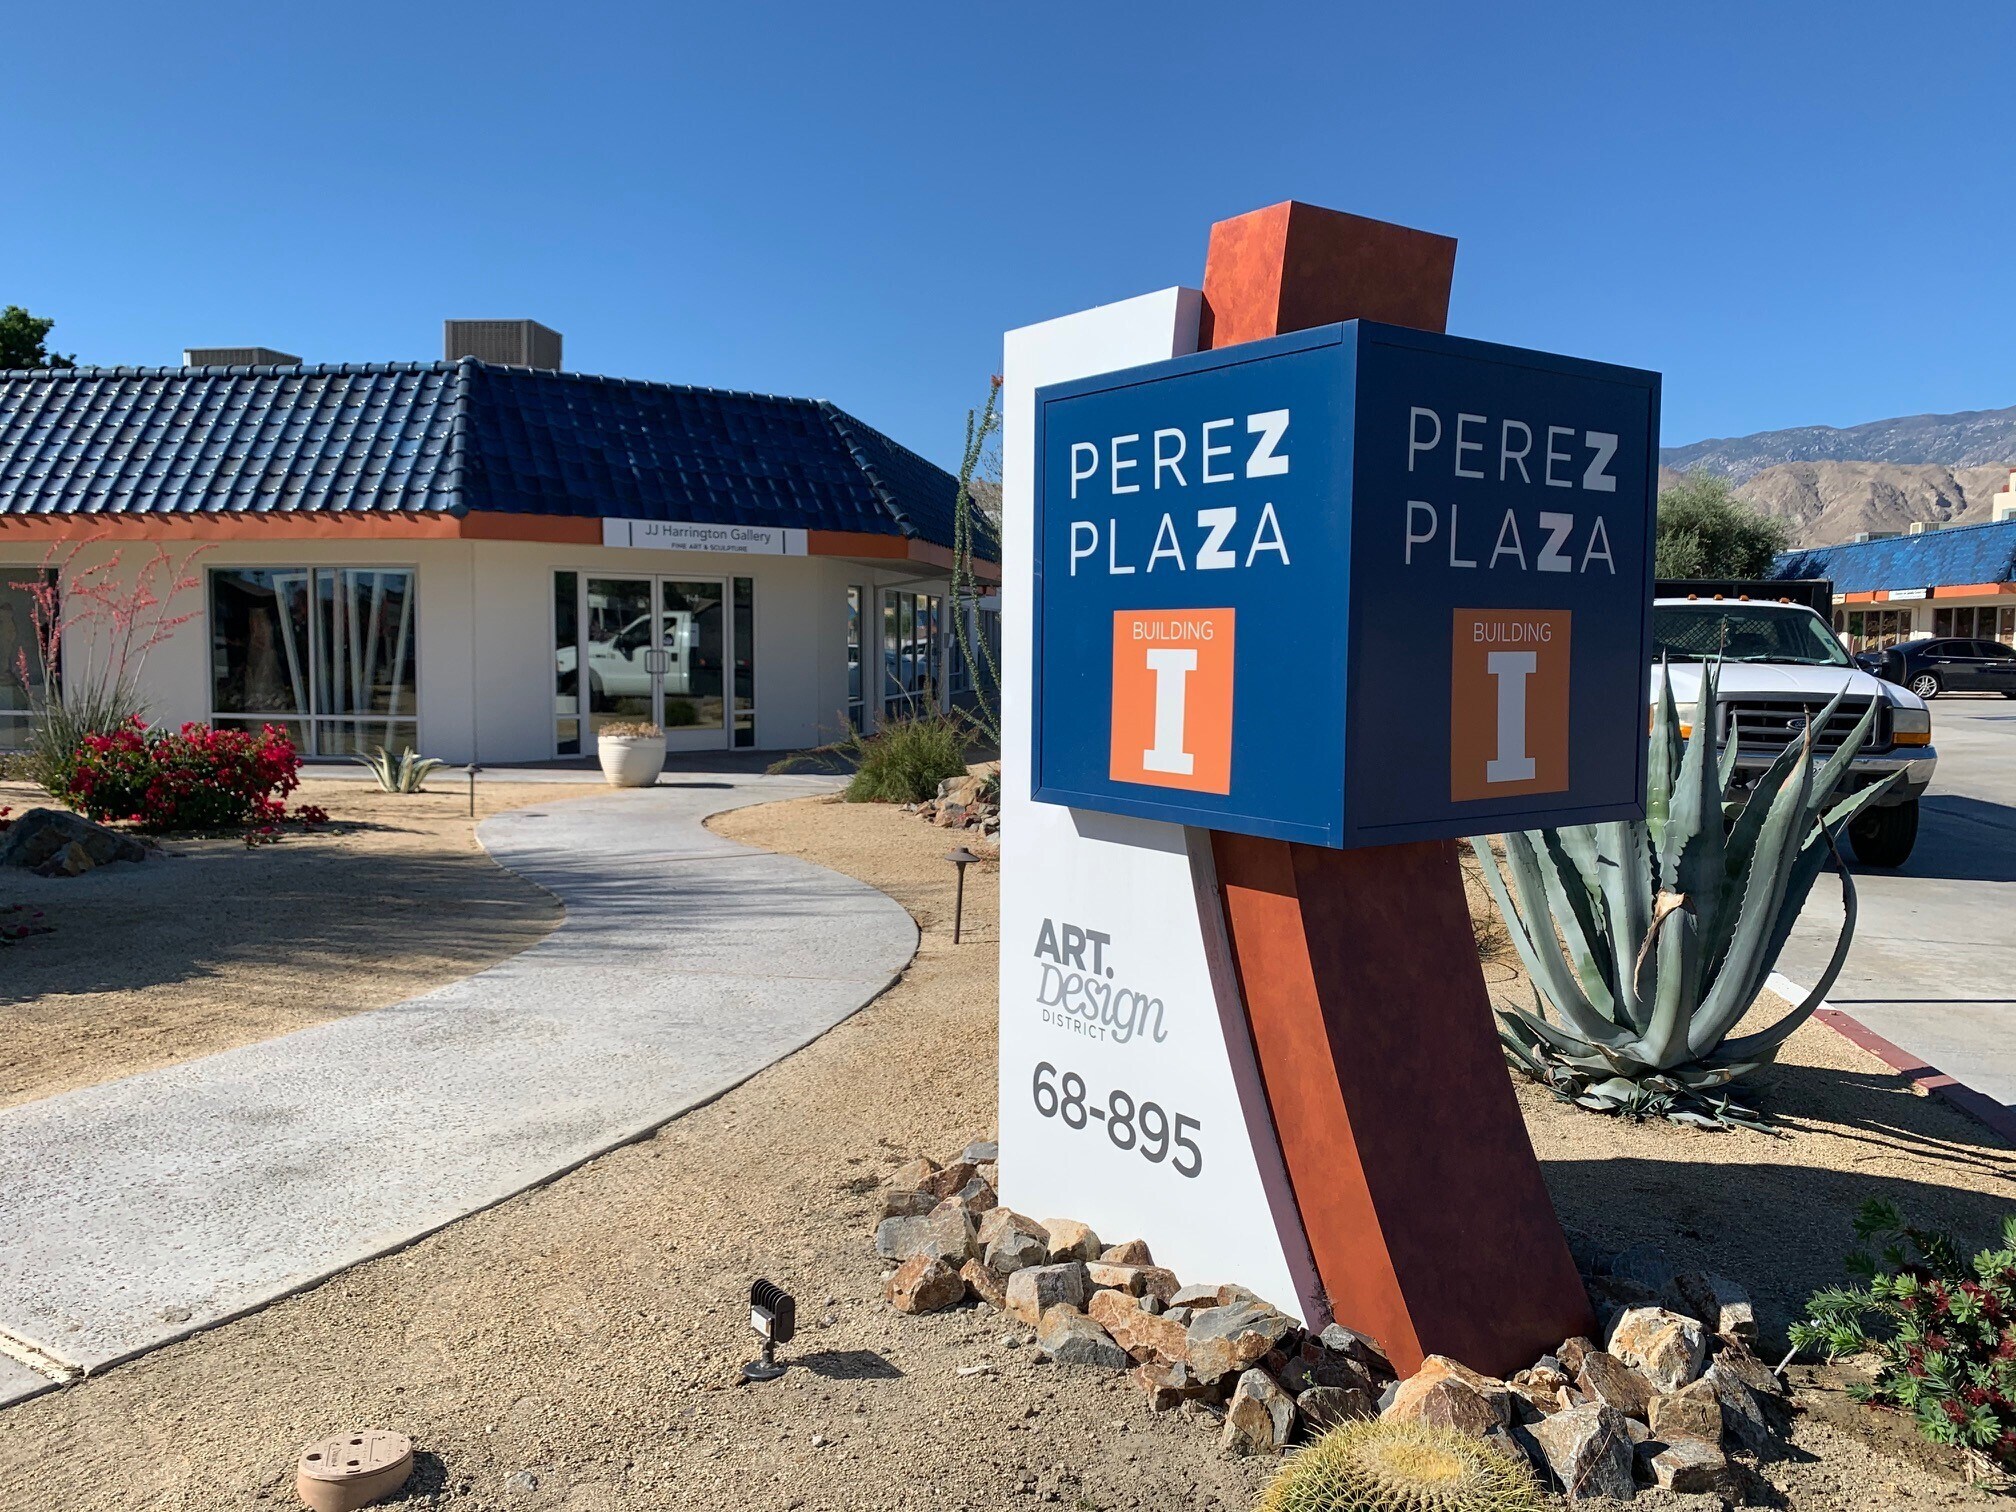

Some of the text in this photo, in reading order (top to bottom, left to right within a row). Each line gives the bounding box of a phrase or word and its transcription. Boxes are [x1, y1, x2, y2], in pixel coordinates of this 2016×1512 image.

[1071, 408, 1290, 499] PEREZ
[1408, 406, 1618, 492] PEREZ
[645, 524, 771, 545] JJ Harrington Gallery
[709, 544, 747, 552] SCULPTURE
[1070, 502, 1291, 576] PLAZA
[1405, 501, 1616, 575] PLAZA
[1132, 620, 1214, 642] BUILDING
[1473, 622, 1552, 643] BUILDING
[1143, 648, 1198, 775] I
[1487, 651, 1537, 783] I
[1033, 917, 1114, 980] ART.
[1036, 962, 1168, 1044] Design
[1042, 1009, 1106, 1042] DISTRICT
[1033, 1061, 1202, 1179] 68-895
